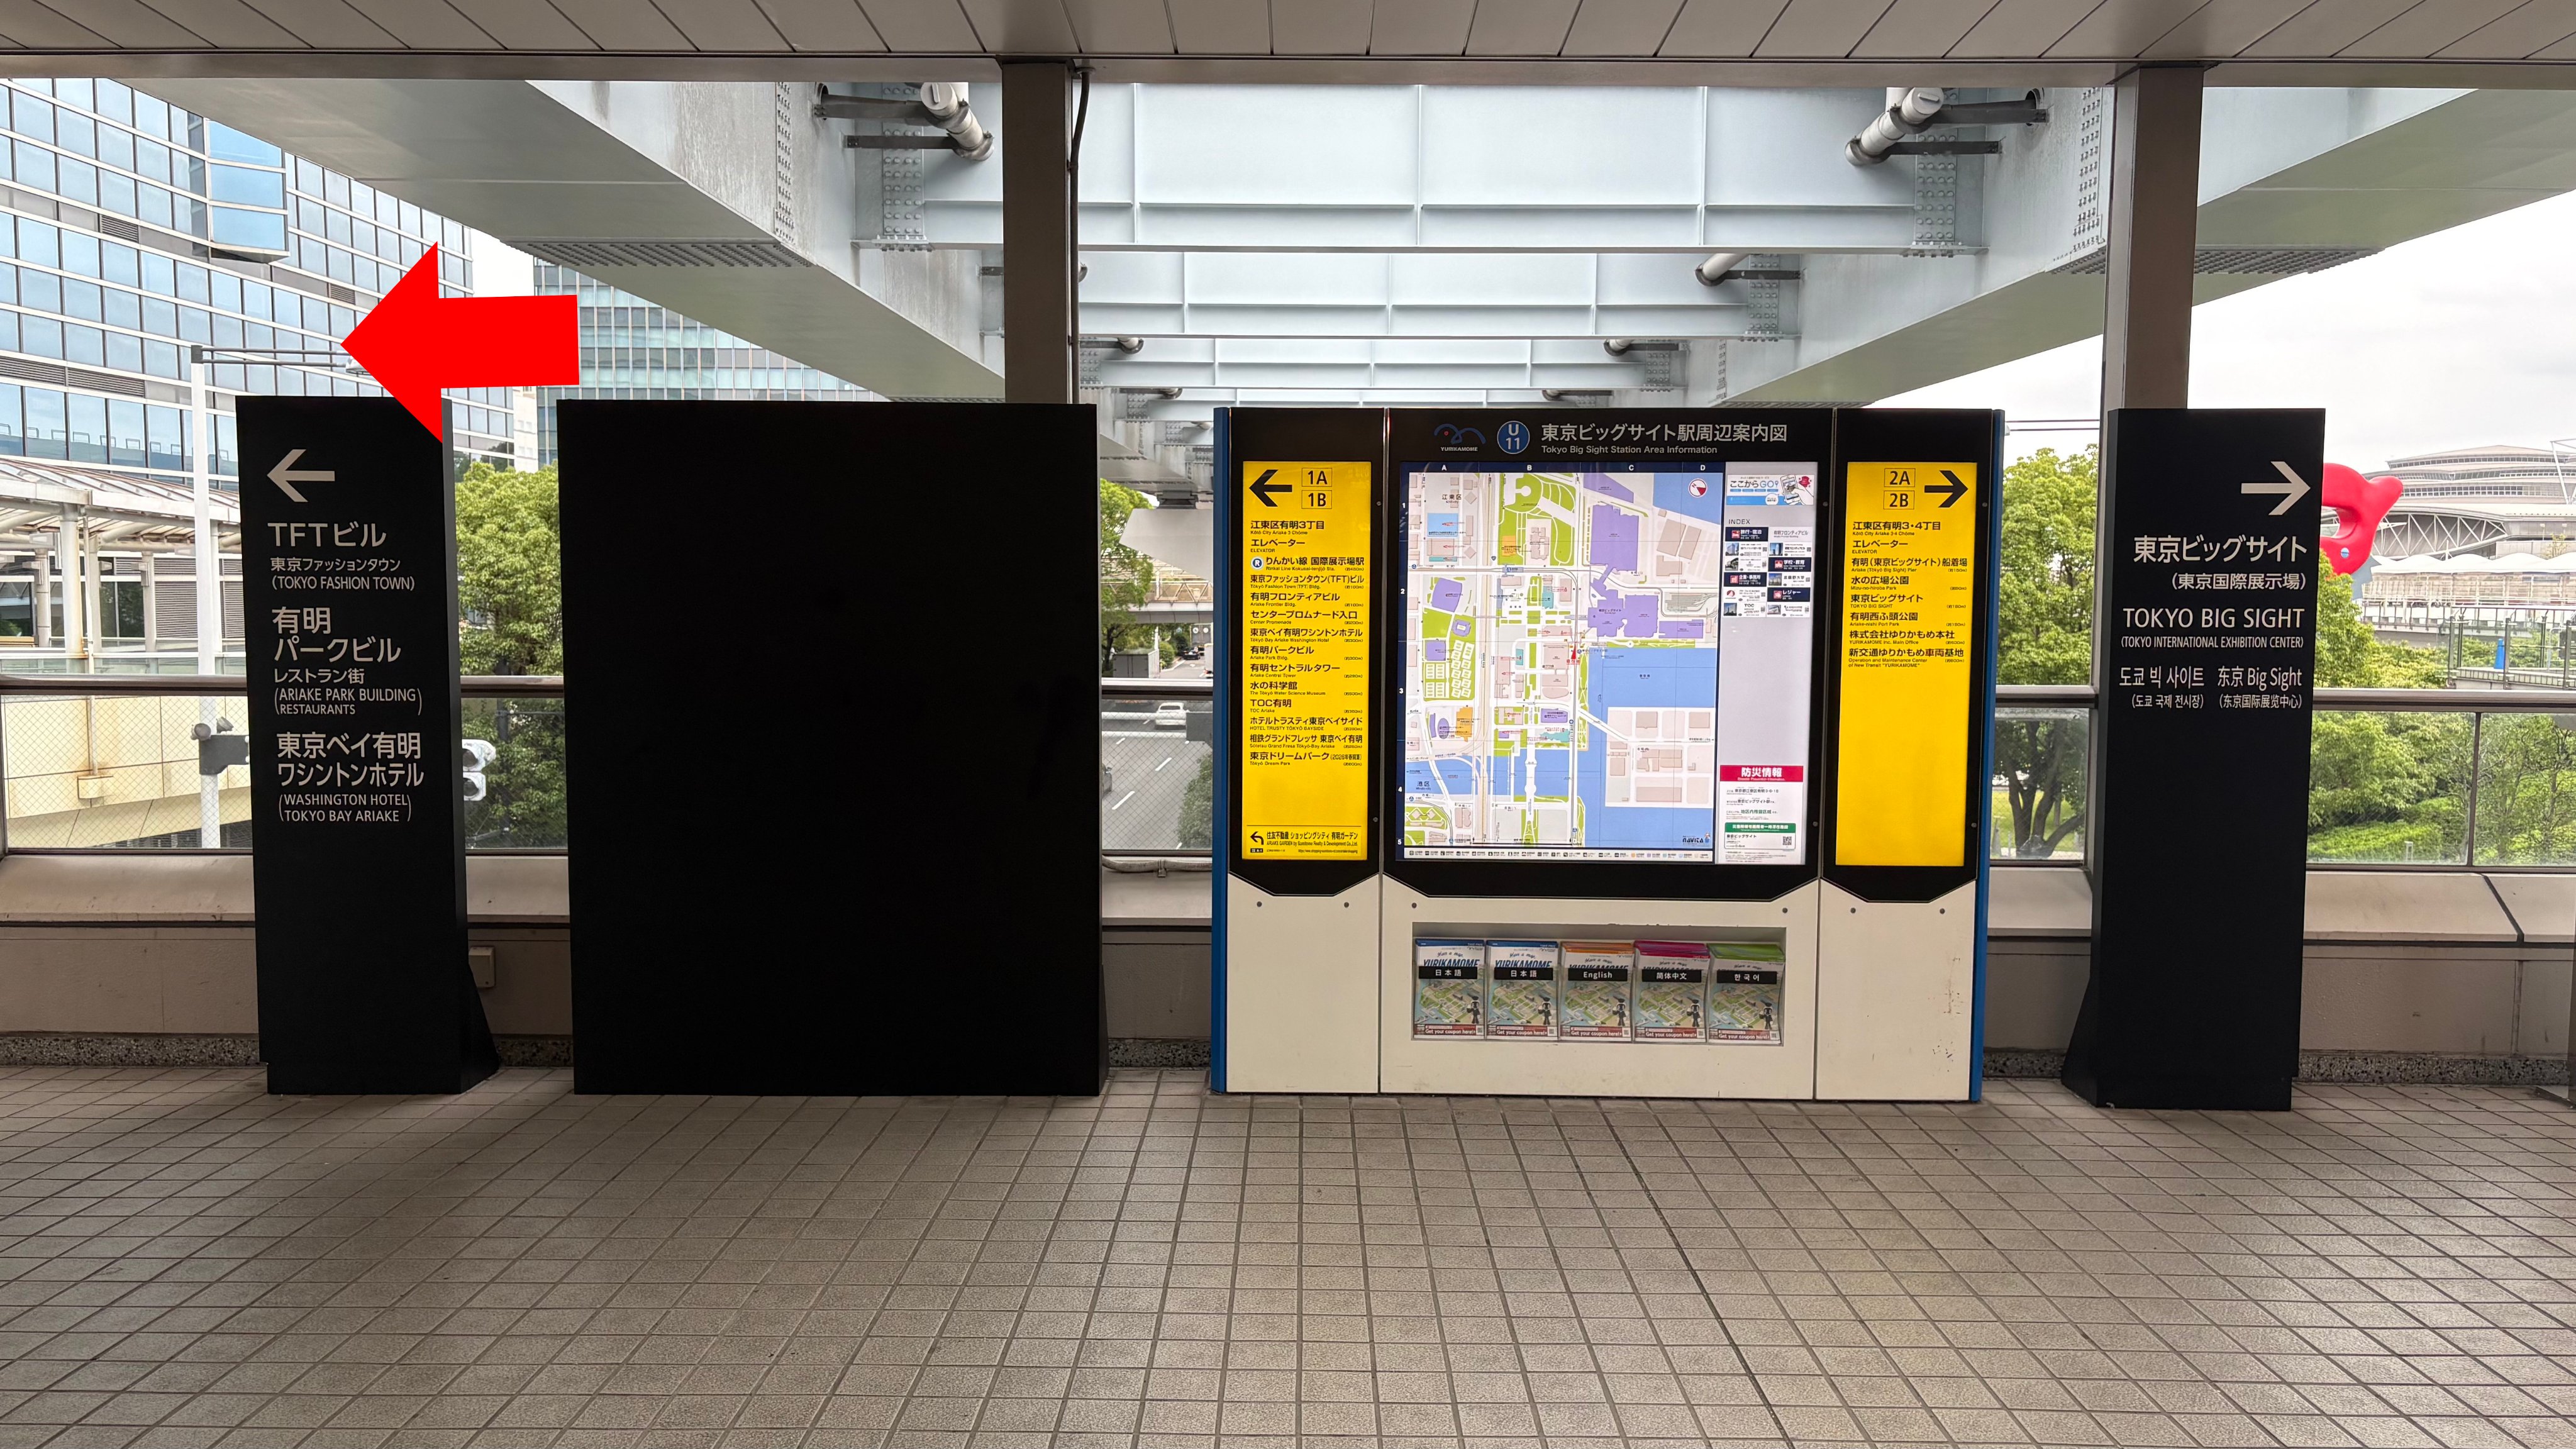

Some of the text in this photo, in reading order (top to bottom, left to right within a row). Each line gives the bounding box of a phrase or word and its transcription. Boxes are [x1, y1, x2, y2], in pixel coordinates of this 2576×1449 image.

[1507, 423, 1519, 435] U
[1541, 423, 1787, 441] 東京ビッグサイト駅周辺案内図
[1505, 438, 1519, 450] 11
[1541, 446, 1567, 454] Tokyo
[1570, 446, 1583, 454] Big
[1586, 446, 1608, 454] Sight
[1308, 470, 1327, 484] 1A
[1890, 471, 1910, 485] 2A
[1308, 493, 1326, 506] 1B
[1890, 493, 1908, 507] 2B
[1251, 521, 1324, 529] 江東区有明3丁目
[1853, 521, 1940, 530] 江東区有明3・4丁目
[268, 521, 386, 547] TFTビル
[1853, 540, 1908, 548] エレベーター
[2134, 535, 2307, 563] 東京ビッグサイト
[270, 557, 400, 571] 東京ファッションタウン
[1267, 557, 1364, 565] りんかい線 国際展示場駅
[272, 575, 414, 591] (TOKYO FASHION TOWN)
[1251, 575, 1364, 584] 東京ファッションタウン(TFT)ビル
[1852, 576, 1909, 584] 水の広場公園
[2172, 573, 2306, 589] (東京国際展示場)
[1250, 592, 1340, 601] 有明フロンティアビル
[1851, 594, 1923, 602] 東京ビッグサイト
[272, 606, 331, 635] 有明
[1251, 611, 1357, 619] センタープロムナード入口
[1850, 612, 1918, 621] 有明西ふ頭公園
[2123, 608, 2304, 628] TOKYO BIG SIGHT
[1250, 628, 1362, 636] 東京ベイ有明ワシントンホテル
[1850, 630, 1955, 639] 株式会社ゆりかもめ本社
[2121, 636, 2303, 648] (TOKYO INTERNATIONAL EXHIBITION CENTER)
[274, 637, 401, 662] パークビル
[1250, 646, 1314, 654] 有明パークビル
[1849, 648, 1963, 657] 新交通ゆりかもめ車両基地
[1250, 663, 1340, 672] 有明セントラルタワー
[275, 668, 364, 684] レストラン街
[2119, 666, 2204, 689] 도쿄 빅 사이트
[2218, 666, 2302, 691] 东京 Big Sight
[1250, 681, 1297, 689] 水の科学館
[326, 689, 355, 701] PARK
[2132, 694, 2203, 708] (도쿄 국제 전시장)
[2220, 694, 2302, 708] (东京国际展览中心)
[279, 704, 355, 714] RESTAURANTS
[1250, 699, 1291, 708] TOC有明
[1250, 717, 1362, 726] ホテルトラスティ東京ベイサイド
[277, 731, 420, 758] 東京ベイ有明
[1320, 735, 1362, 743] 東京ベイ有明
[279, 762, 424, 787] ワシントンホテル
[1741, 767, 1782, 778] 防災情報
[330, 811, 350, 821] BAY
